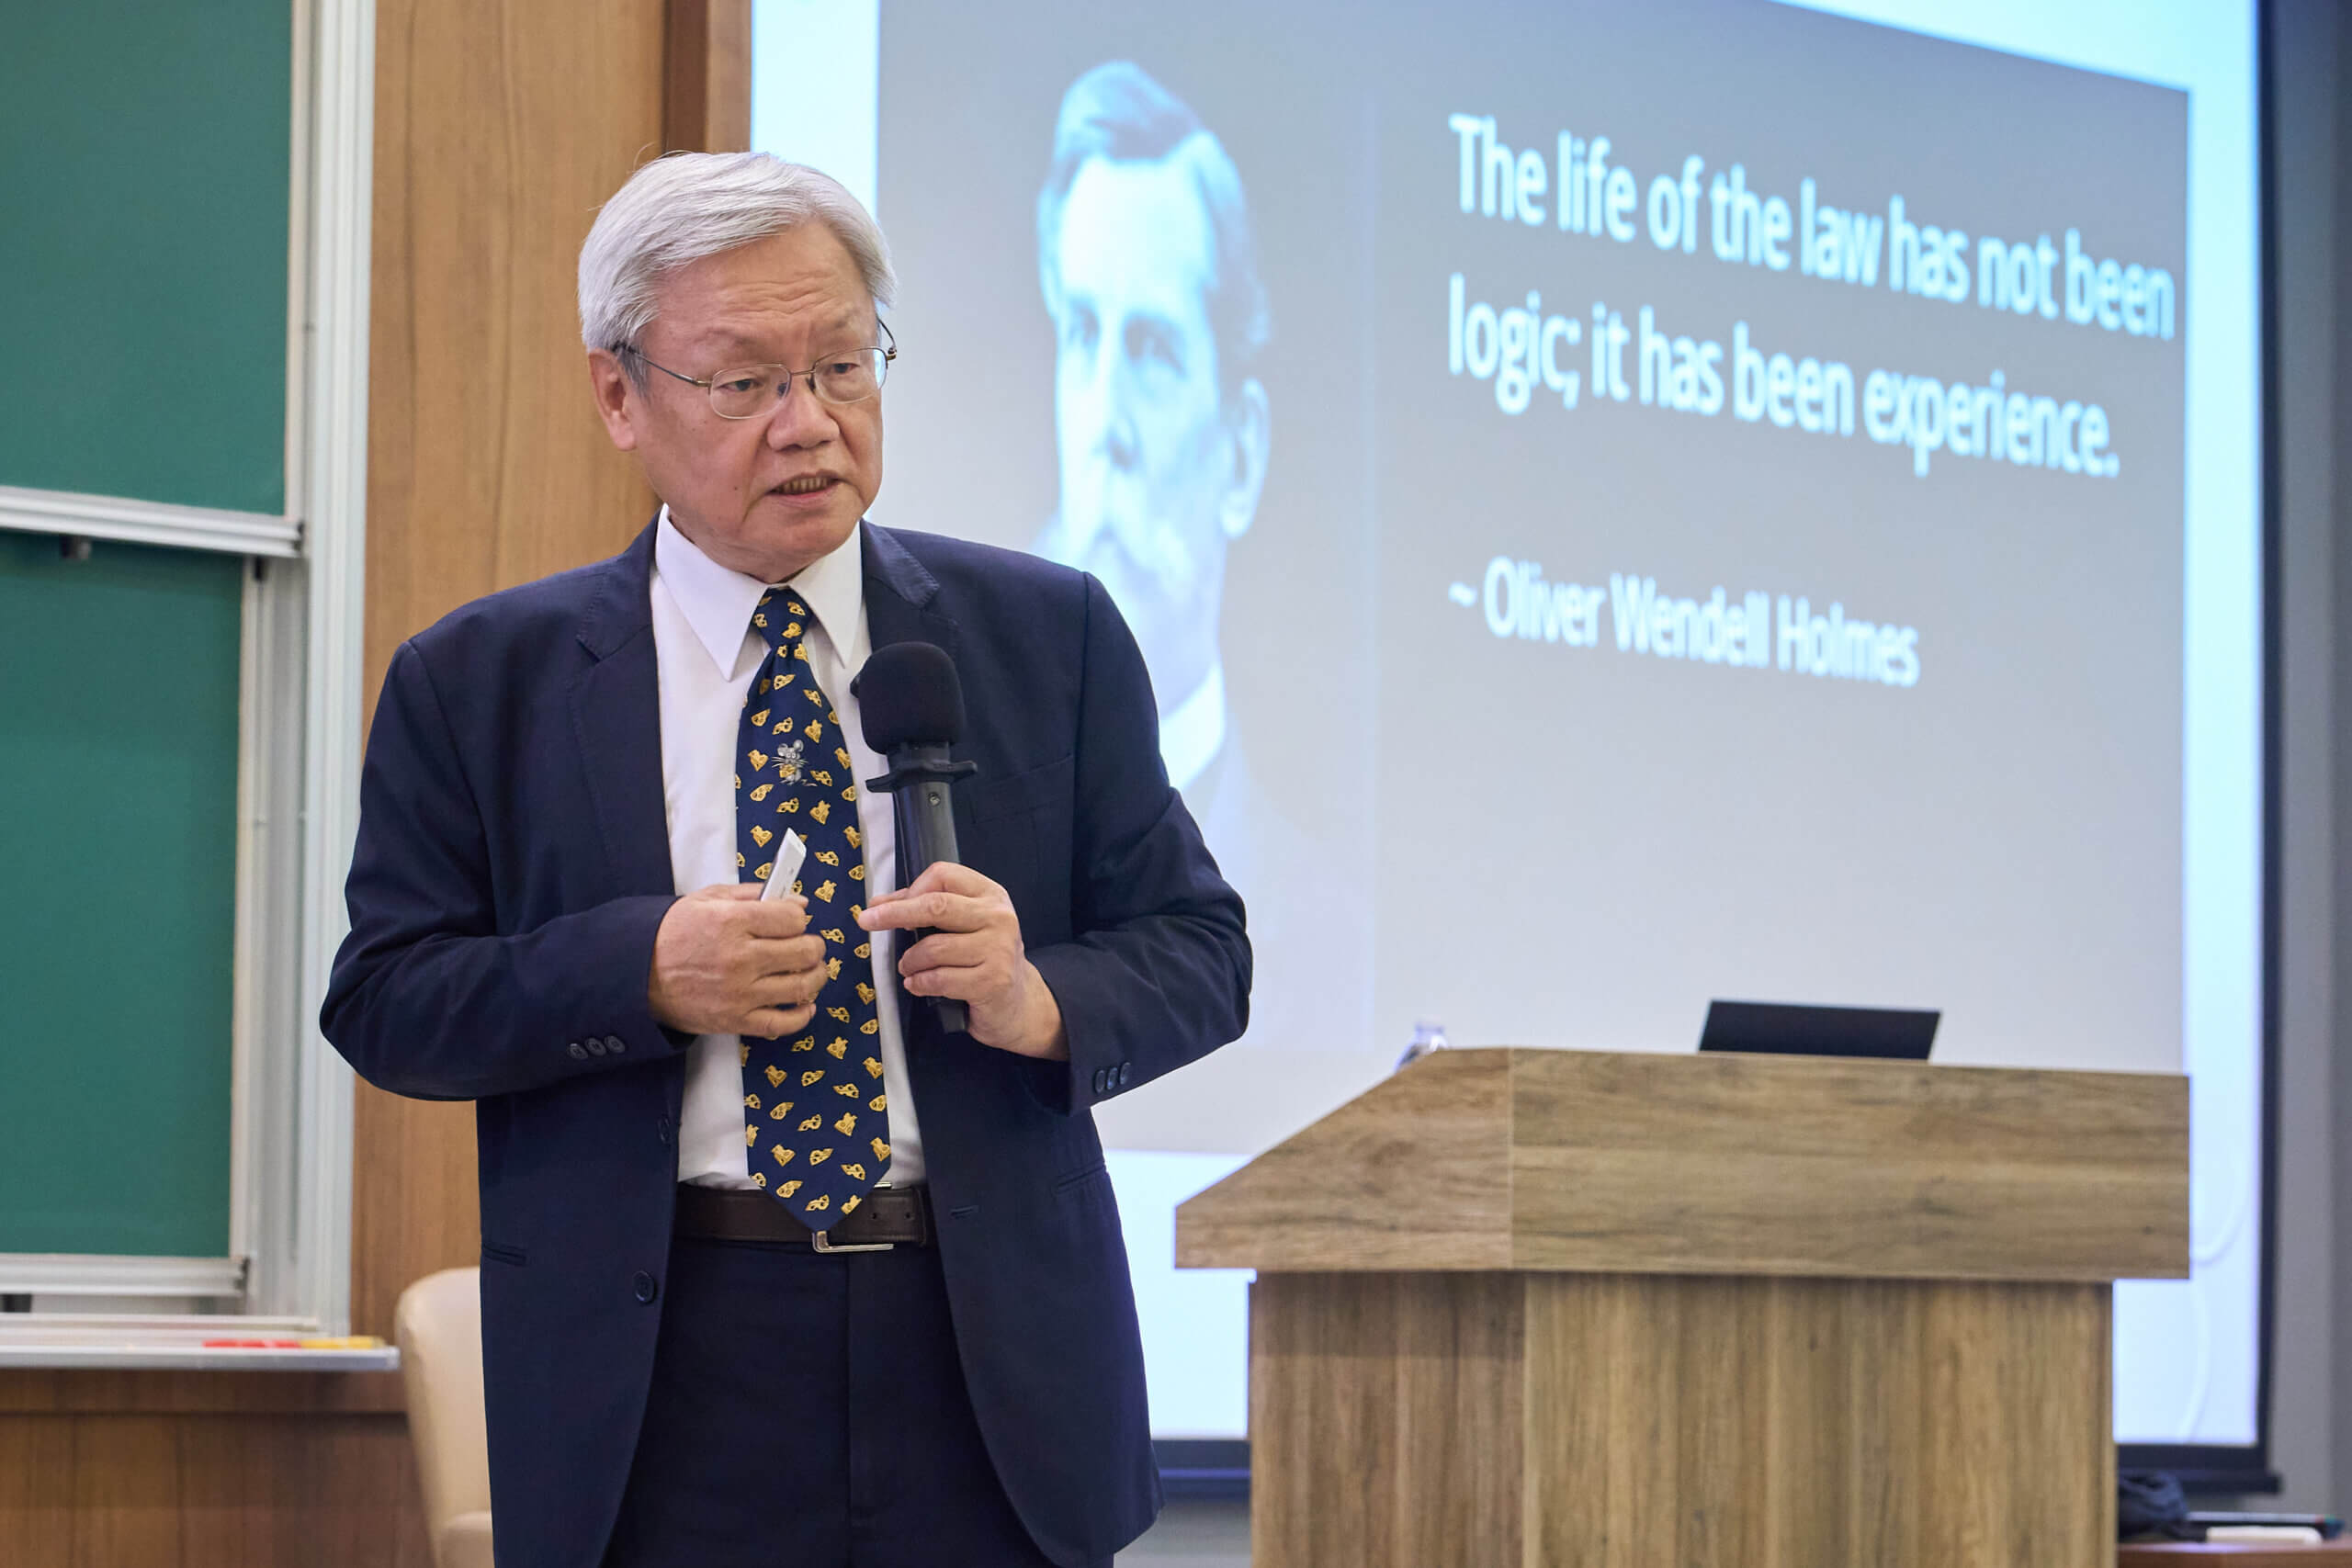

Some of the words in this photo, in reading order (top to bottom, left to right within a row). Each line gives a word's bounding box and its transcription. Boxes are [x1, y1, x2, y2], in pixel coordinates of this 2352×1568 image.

[1448, 113, 1547, 225] The
[1558, 129, 1636, 242] life
[1648, 153, 1704, 254] of
[1710, 164, 1792, 271] the
[1801, 177, 1883, 287] law
[1889, 194, 1969, 302] has
[1979, 234, 2059, 319] not
[2065, 228, 2175, 340] been
[1592, 302, 1630, 401] it
[1639, 305, 1724, 415] has
[1734, 321, 1854, 436] been
[1864, 369, 2120, 478] experience.
[1484, 556, 1605, 647] Oliver
[1611, 572, 1770, 669] Wendell
[1777, 598, 1920, 687] Holmes
